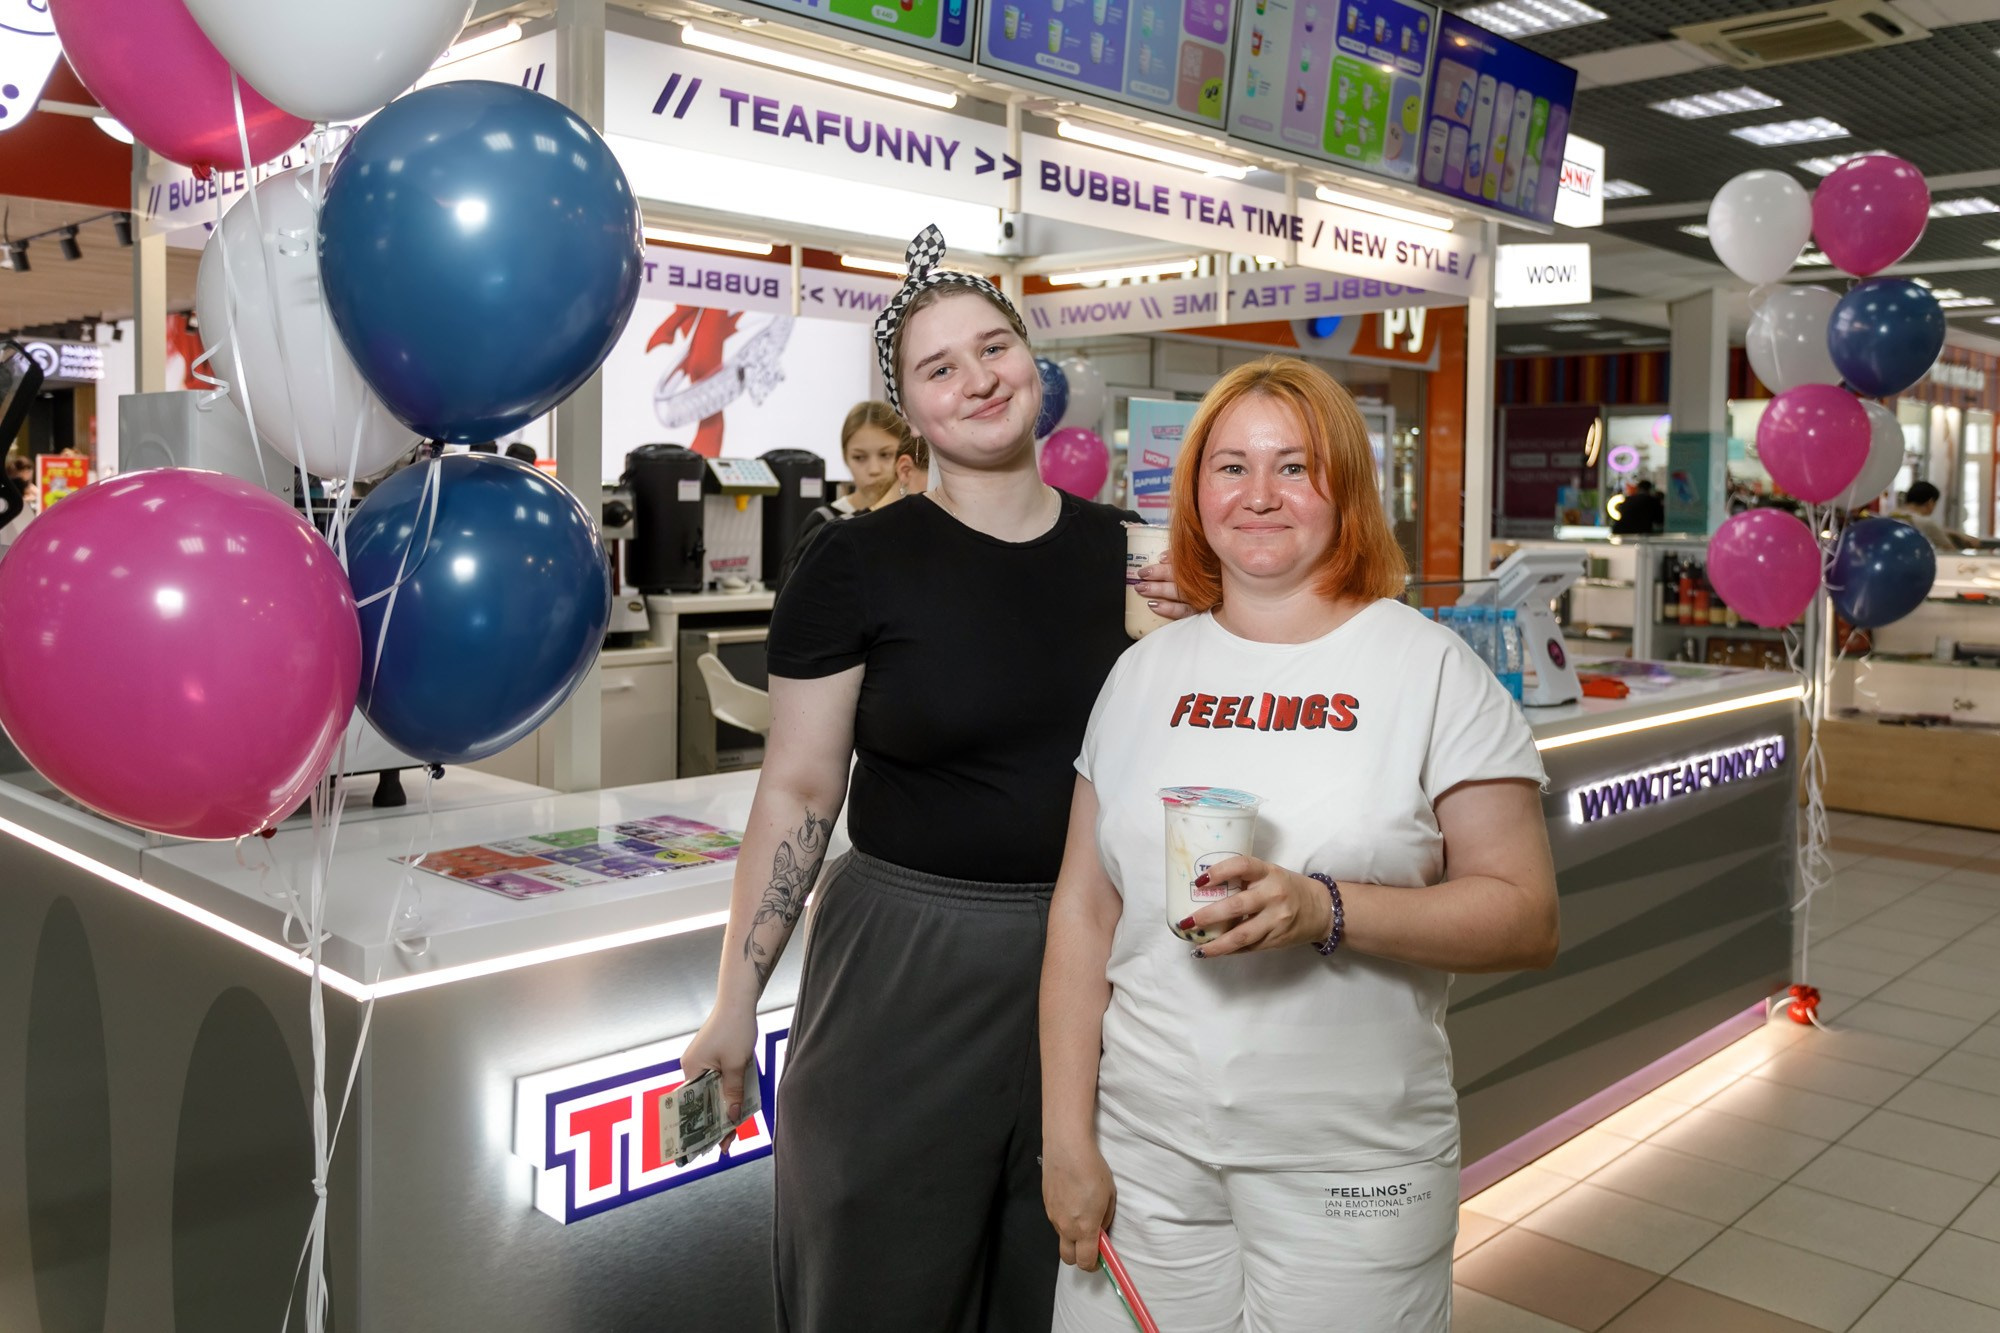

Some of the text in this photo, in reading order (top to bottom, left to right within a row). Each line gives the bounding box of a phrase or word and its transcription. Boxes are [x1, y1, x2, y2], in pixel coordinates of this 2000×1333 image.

[719, 87, 960, 171] TEAFUNNY
[1040, 160, 1170, 215] BUBBLE
[1180, 191, 1235, 229] TEA
[1243, 204, 1303, 242] TIME
[1333, 225, 1387, 259] NEW
[1395, 240, 1459, 277] STYLE
[1527, 264, 1577, 285] WOW!
[1170, 692, 1360, 732] FEELINGS
[1574, 735, 1786, 823] WWW.TEAFUNNY.RU
[684, 1089, 695, 1103] 10
[1324, 1182, 1412, 1198] "FEELINGS"
[1345, 1198, 1404, 1208] EMOTIONAL
[1406, 1191, 1432, 1205] STATE
[1325, 1209, 1341, 1217] OR
